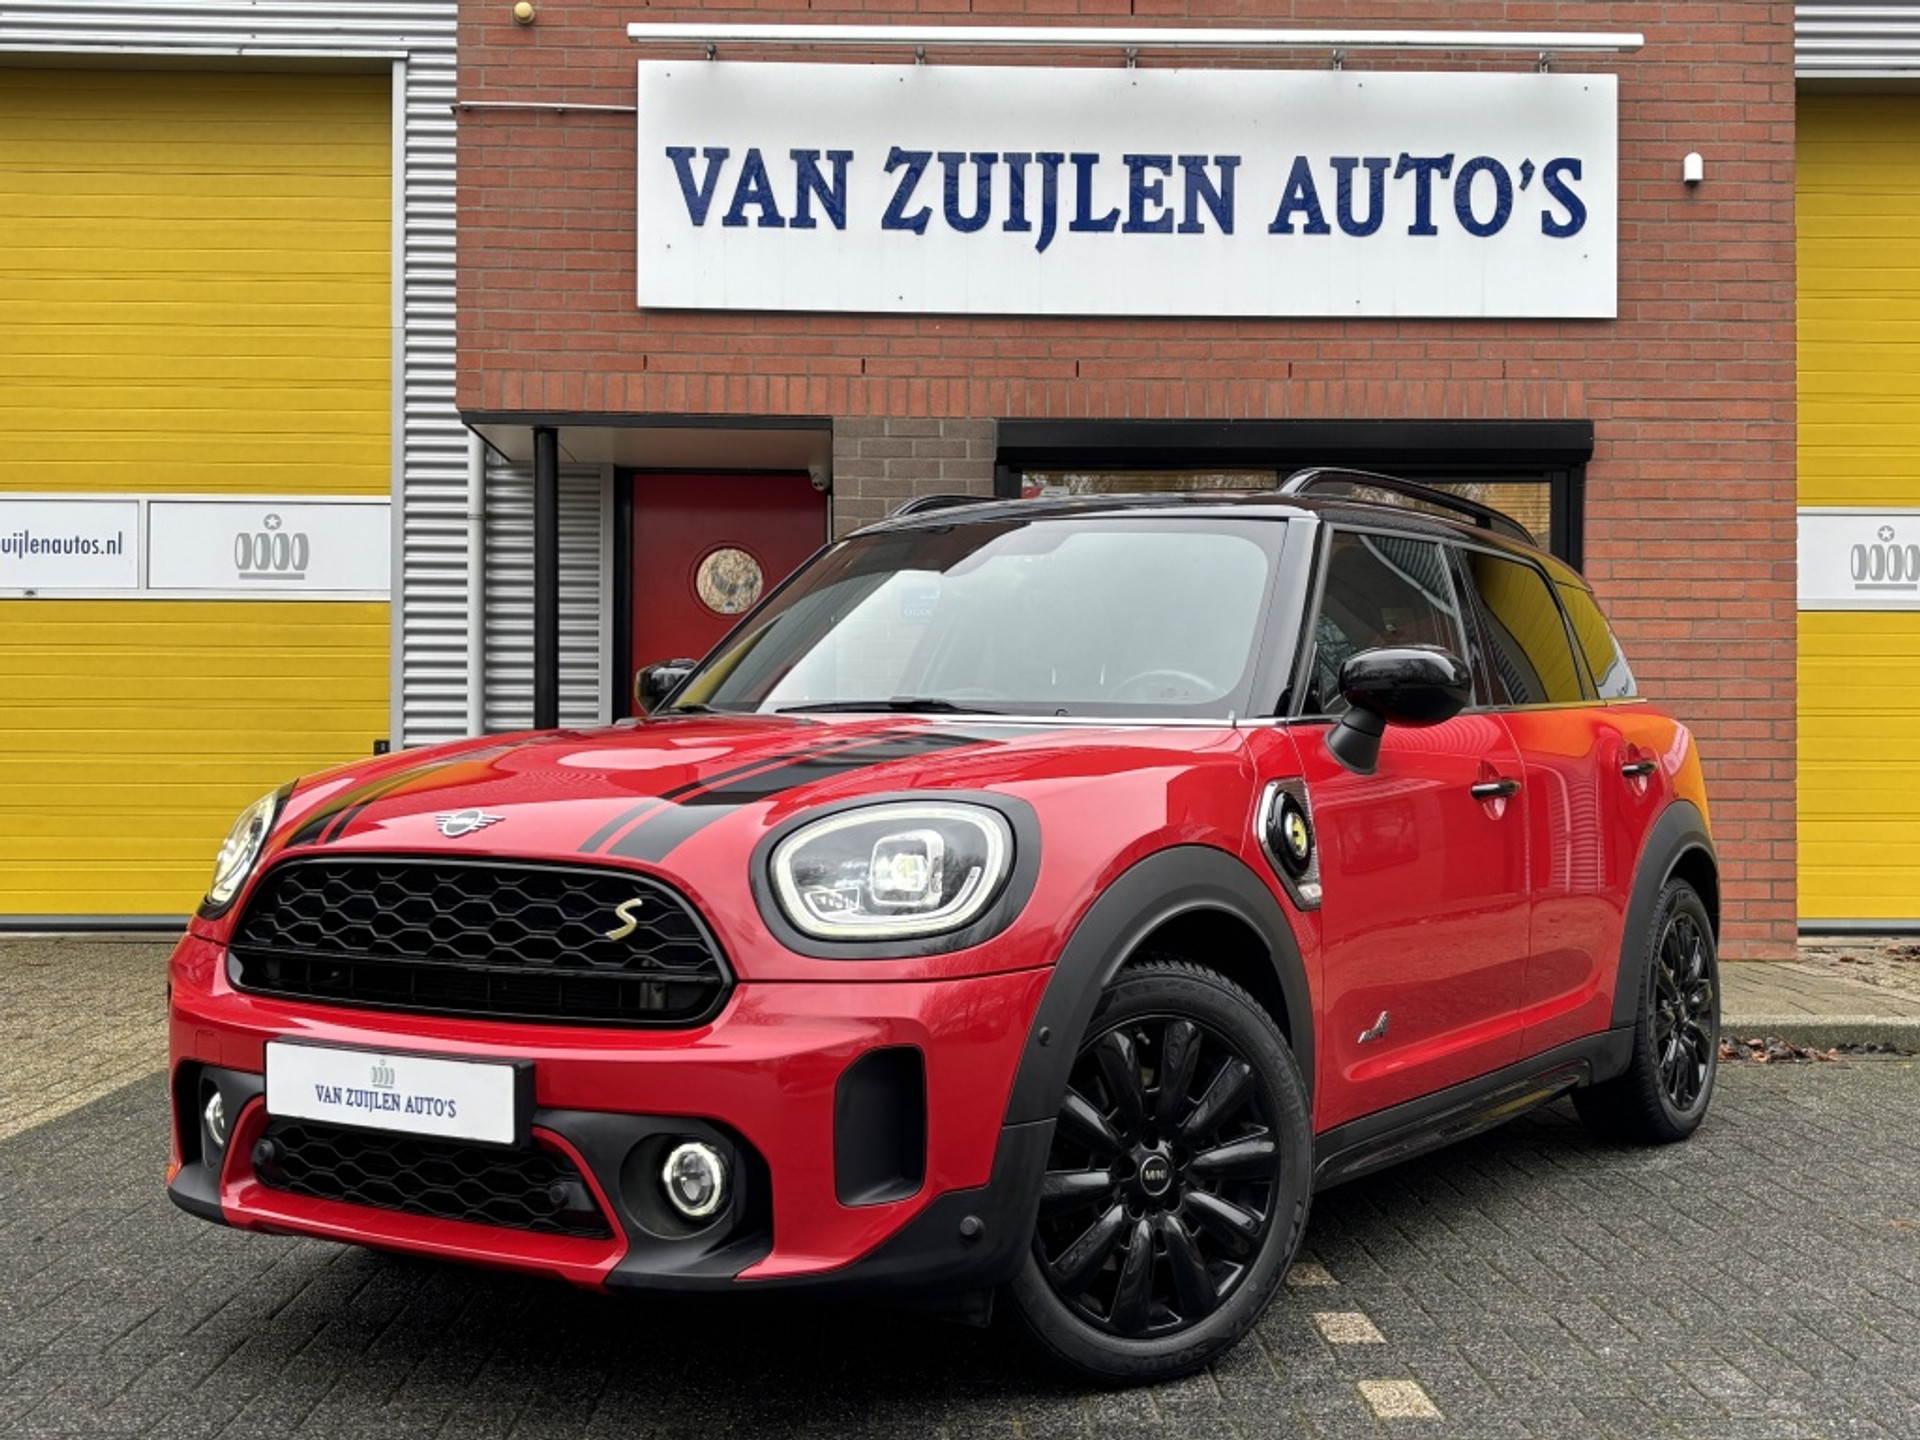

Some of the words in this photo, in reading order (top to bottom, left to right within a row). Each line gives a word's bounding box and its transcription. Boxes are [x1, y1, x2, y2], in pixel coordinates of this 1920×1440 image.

[665, 146, 854, 231] VAN
[881, 146, 1241, 254] ZUIJLEN
[1268, 152, 1588, 238] AUTO'S
[1, 530, 123, 559] uijlenautos.nl
[315, 1084, 342, 1105] VAN
[346, 1087, 401, 1112] ZUIJLEN
[404, 1095, 457, 1118] AUTO'S
